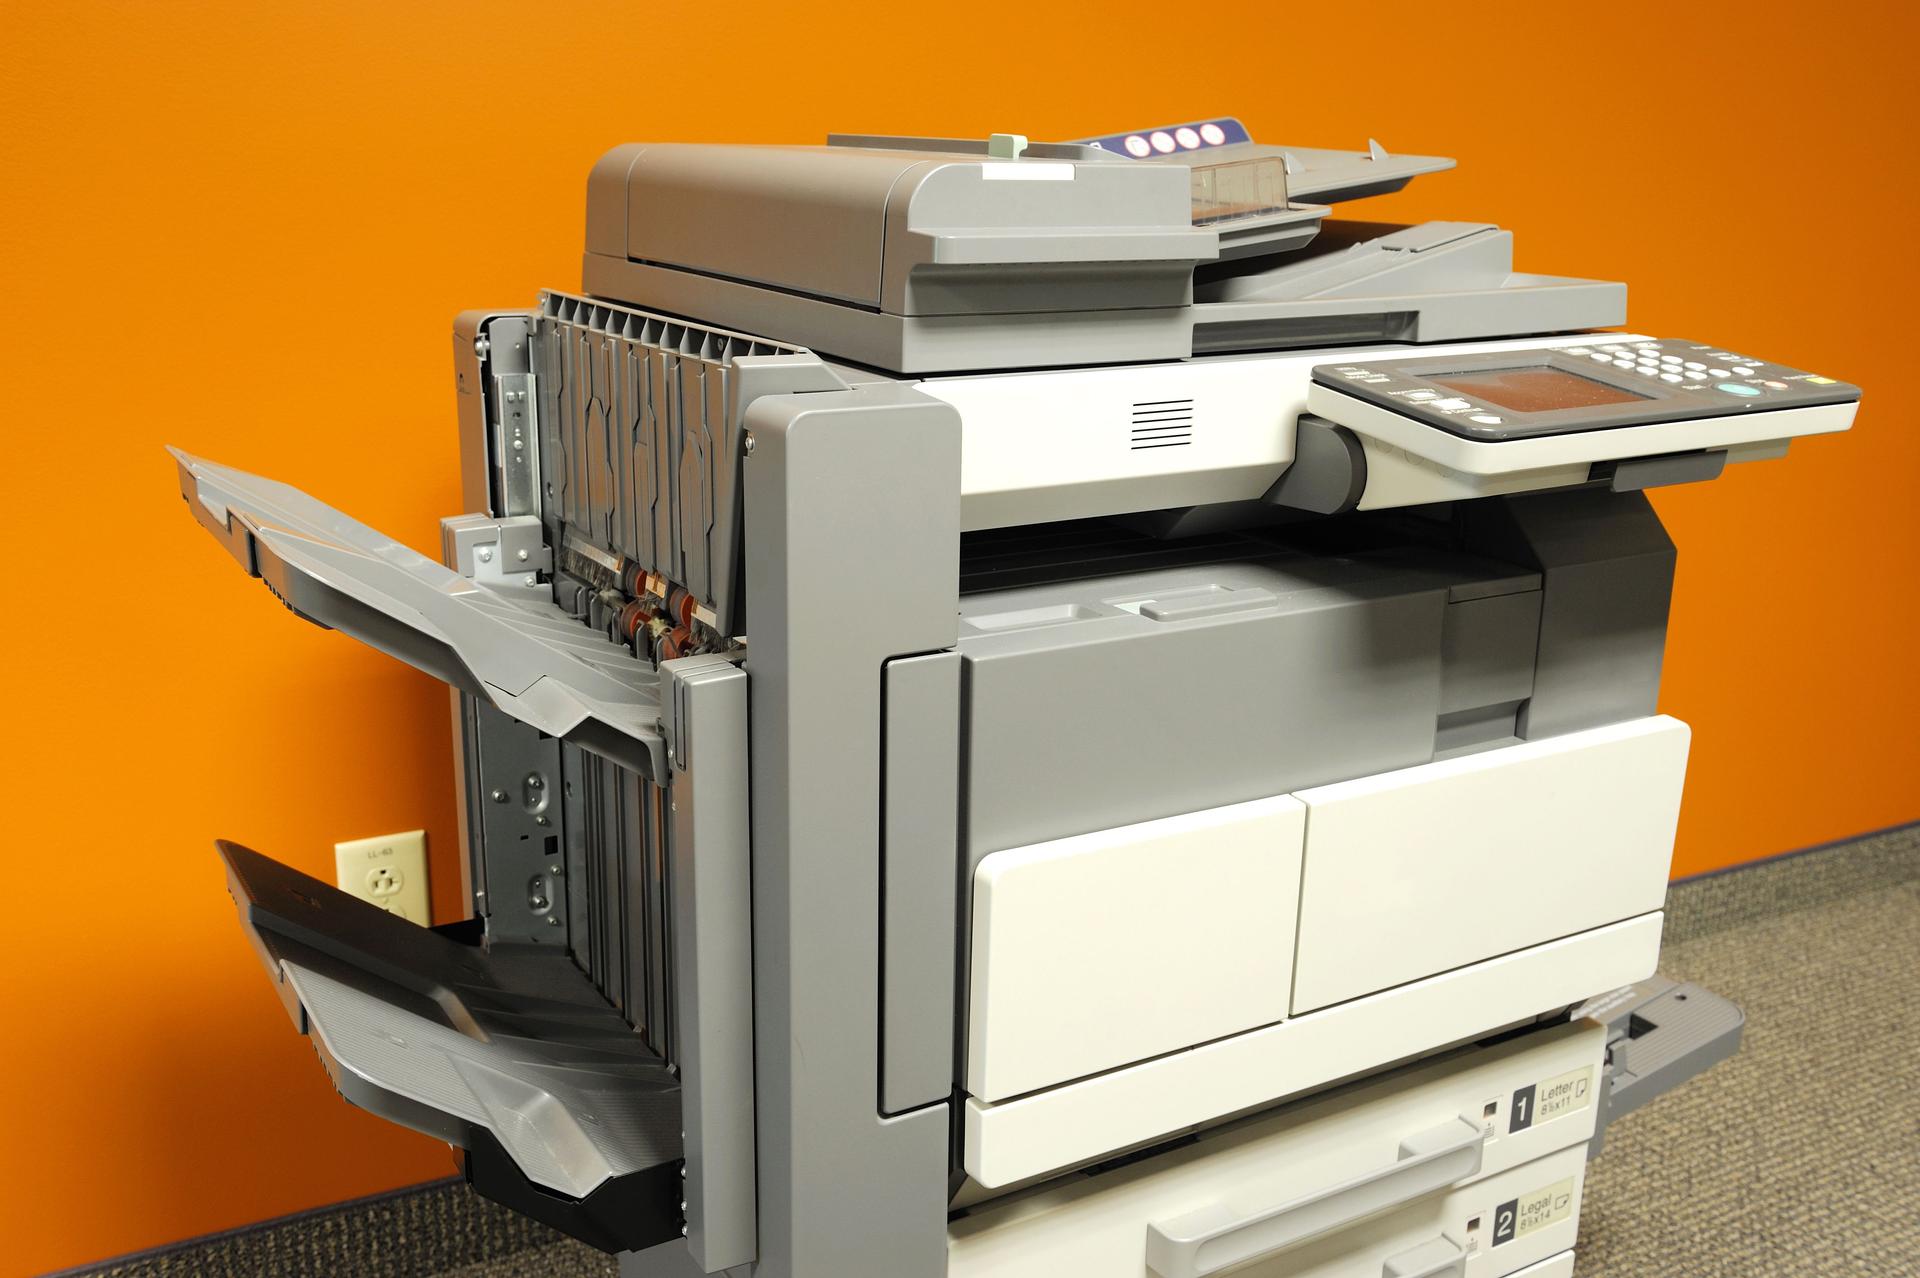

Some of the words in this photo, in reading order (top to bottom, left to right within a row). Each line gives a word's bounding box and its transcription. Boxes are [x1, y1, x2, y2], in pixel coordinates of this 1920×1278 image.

[1541, 1081, 1574, 1102] Letter
[1518, 1096, 1527, 1122] 1
[1521, 1194, 1552, 1216] Legal
[1497, 1211, 1513, 1237] 2
